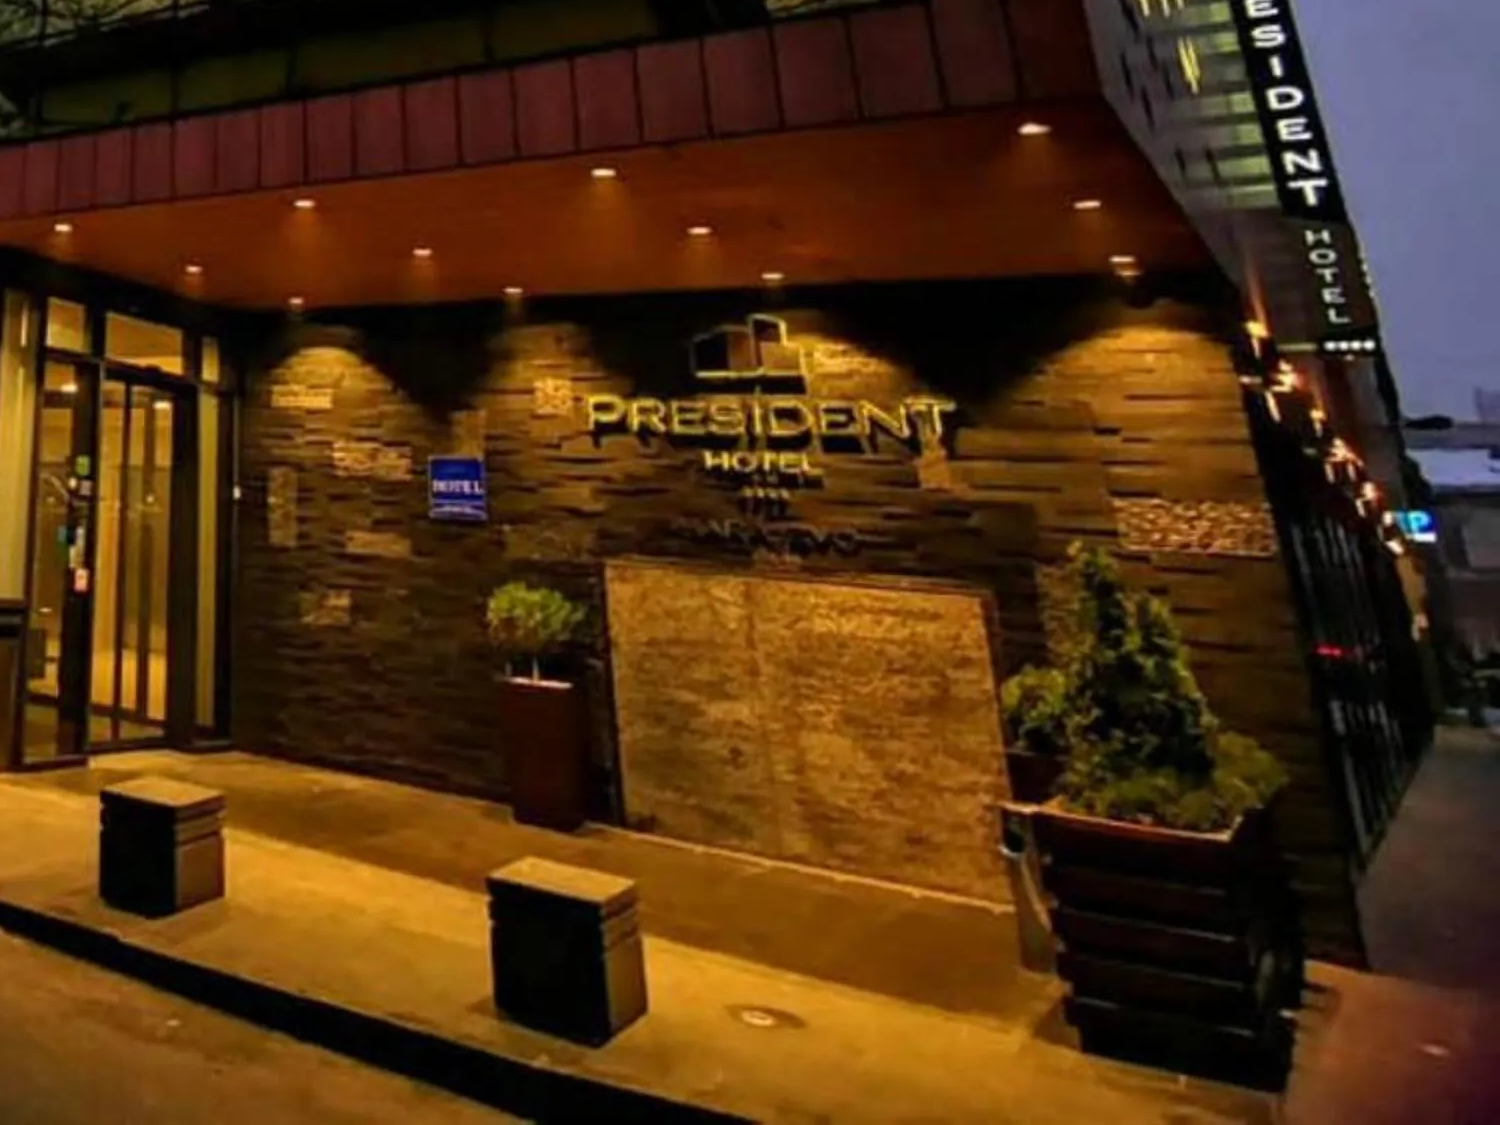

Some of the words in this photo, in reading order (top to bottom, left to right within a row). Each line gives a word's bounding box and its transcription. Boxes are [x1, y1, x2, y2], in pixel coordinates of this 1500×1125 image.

[1304, 230, 1350, 323] HOTEL
[585, 393, 957, 440] PRESIDENT
[703, 451, 824, 476] HOTEL
